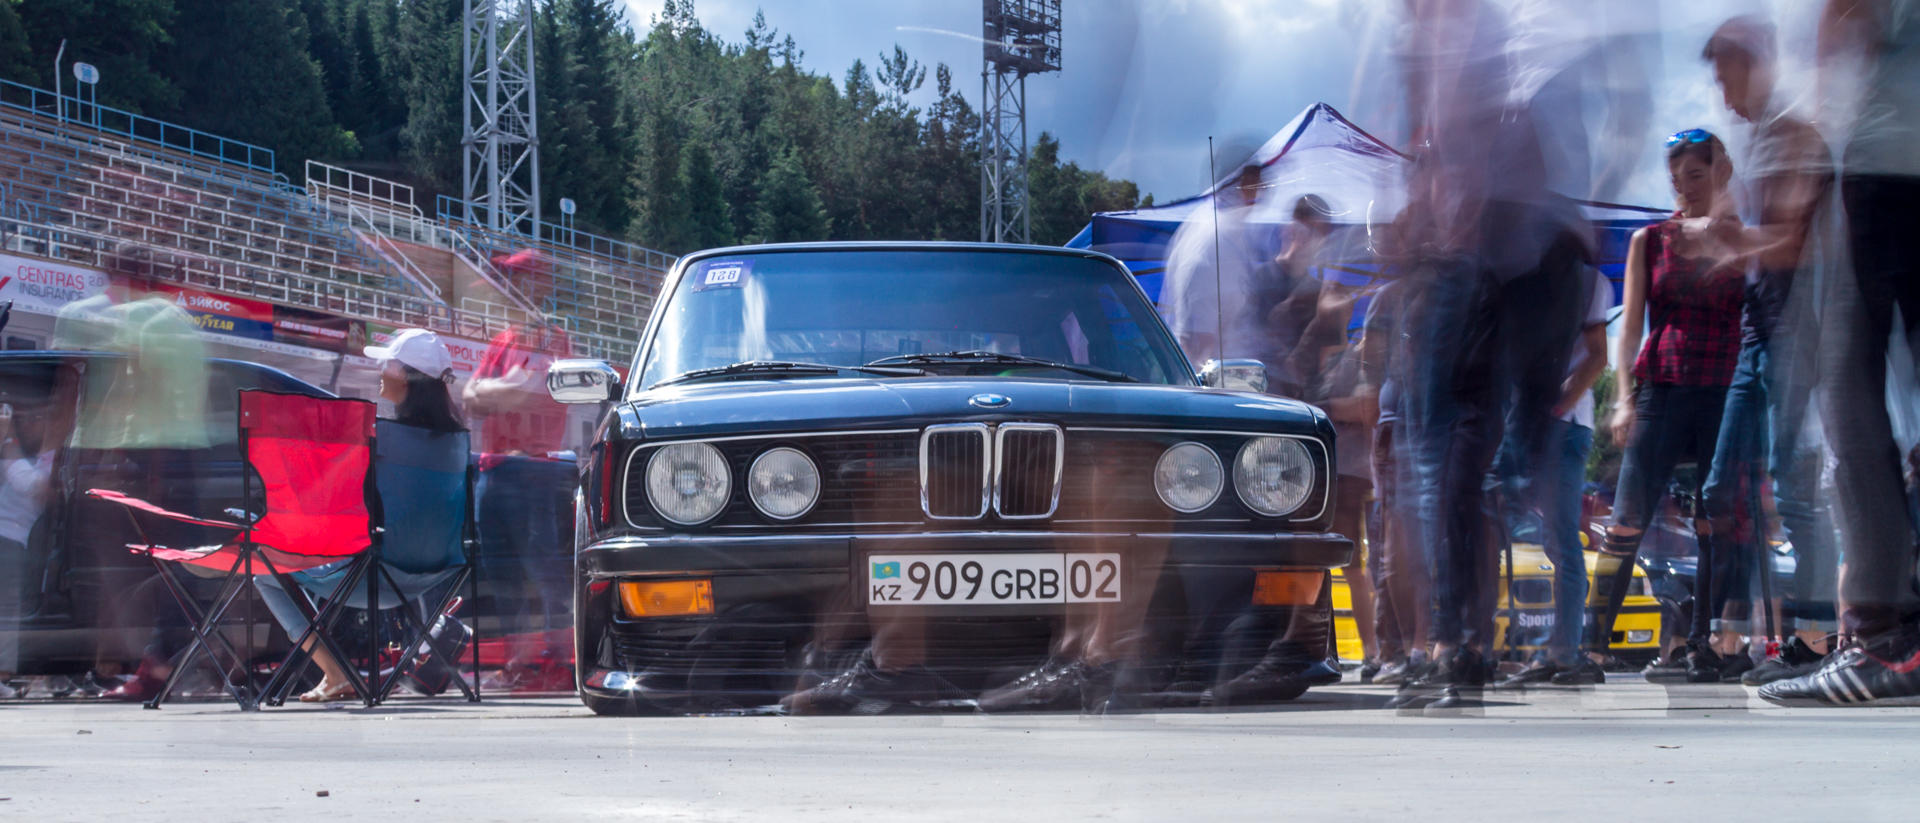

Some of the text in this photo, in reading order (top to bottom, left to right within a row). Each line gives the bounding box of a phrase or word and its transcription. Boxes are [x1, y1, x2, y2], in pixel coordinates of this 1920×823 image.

[17, 265, 84, 290] CENTRAS
[19, 282, 84, 302] INSURANCE
[872, 559, 1118, 601] KZ 909 GRB 02
